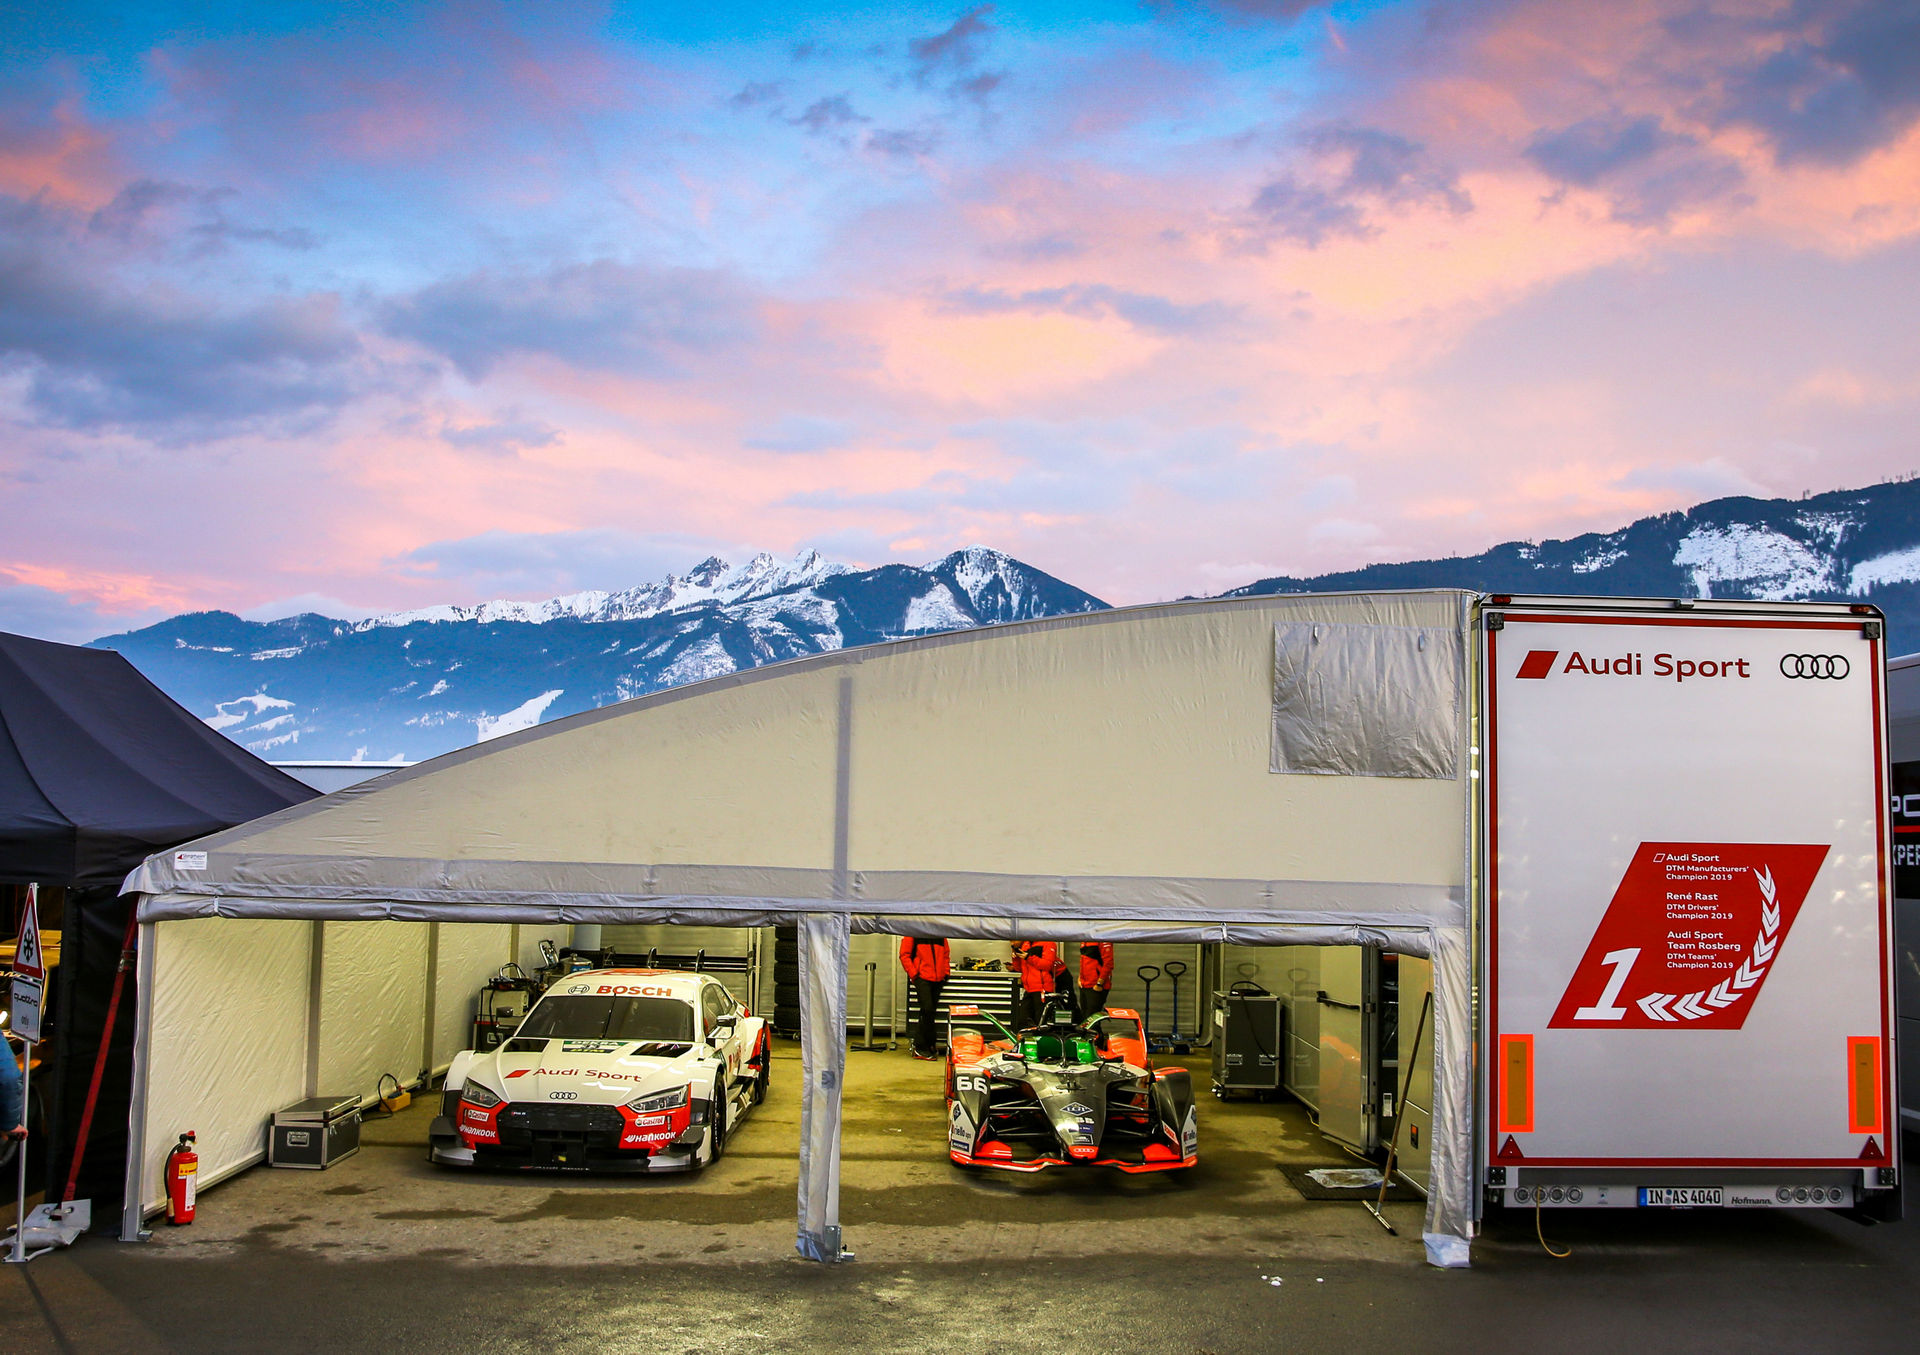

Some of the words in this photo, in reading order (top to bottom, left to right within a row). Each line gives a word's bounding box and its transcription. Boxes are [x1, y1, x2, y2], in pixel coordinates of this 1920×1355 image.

[1563, 651, 1642, 676] Audi
[1653, 653, 1751, 683] Sport
[1666, 853, 1689, 862] Audi
[1691, 853, 1720, 863] Sport
[1665, 864, 1685, 872] DTM
[1686, 865, 1750, 873] Manufacturers'
[1665, 873, 1709, 881] Champion
[1710, 873, 1733, 881] 2019
[1666, 892, 1693, 901] René
[1695, 892, 1719, 901] Rast
[1666, 903, 1686, 911] DTM
[1687, 903, 1719, 911] Drivers'
[1666, 912, 1709, 920] Champion
[1711, 912, 1733, 920] 2019
[1667, 931, 1692, 940] Audi
[1694, 931, 1724, 941] Sport
[1667, 941, 1696, 950] Team
[1698, 942, 1741, 952] Rosberg
[1667, 961, 1709, 970] Champion
[1711, 961, 1734, 969] 2019
[1573, 947, 1642, 1020] 1
[596, 985, 672, 997] BOSCH
[14, 992, 38, 1007] quattro
[532, 1068, 579, 1076] Audi
[585, 1069, 642, 1083] Sport
[956, 1076, 988, 1095] 66
[642, 1117, 663, 1125] Castrol
[1649, 1190, 1664, 1204] IN
[1672, 1190, 1688, 1204] AS
[1690, 1190, 1722, 1204] 4040
